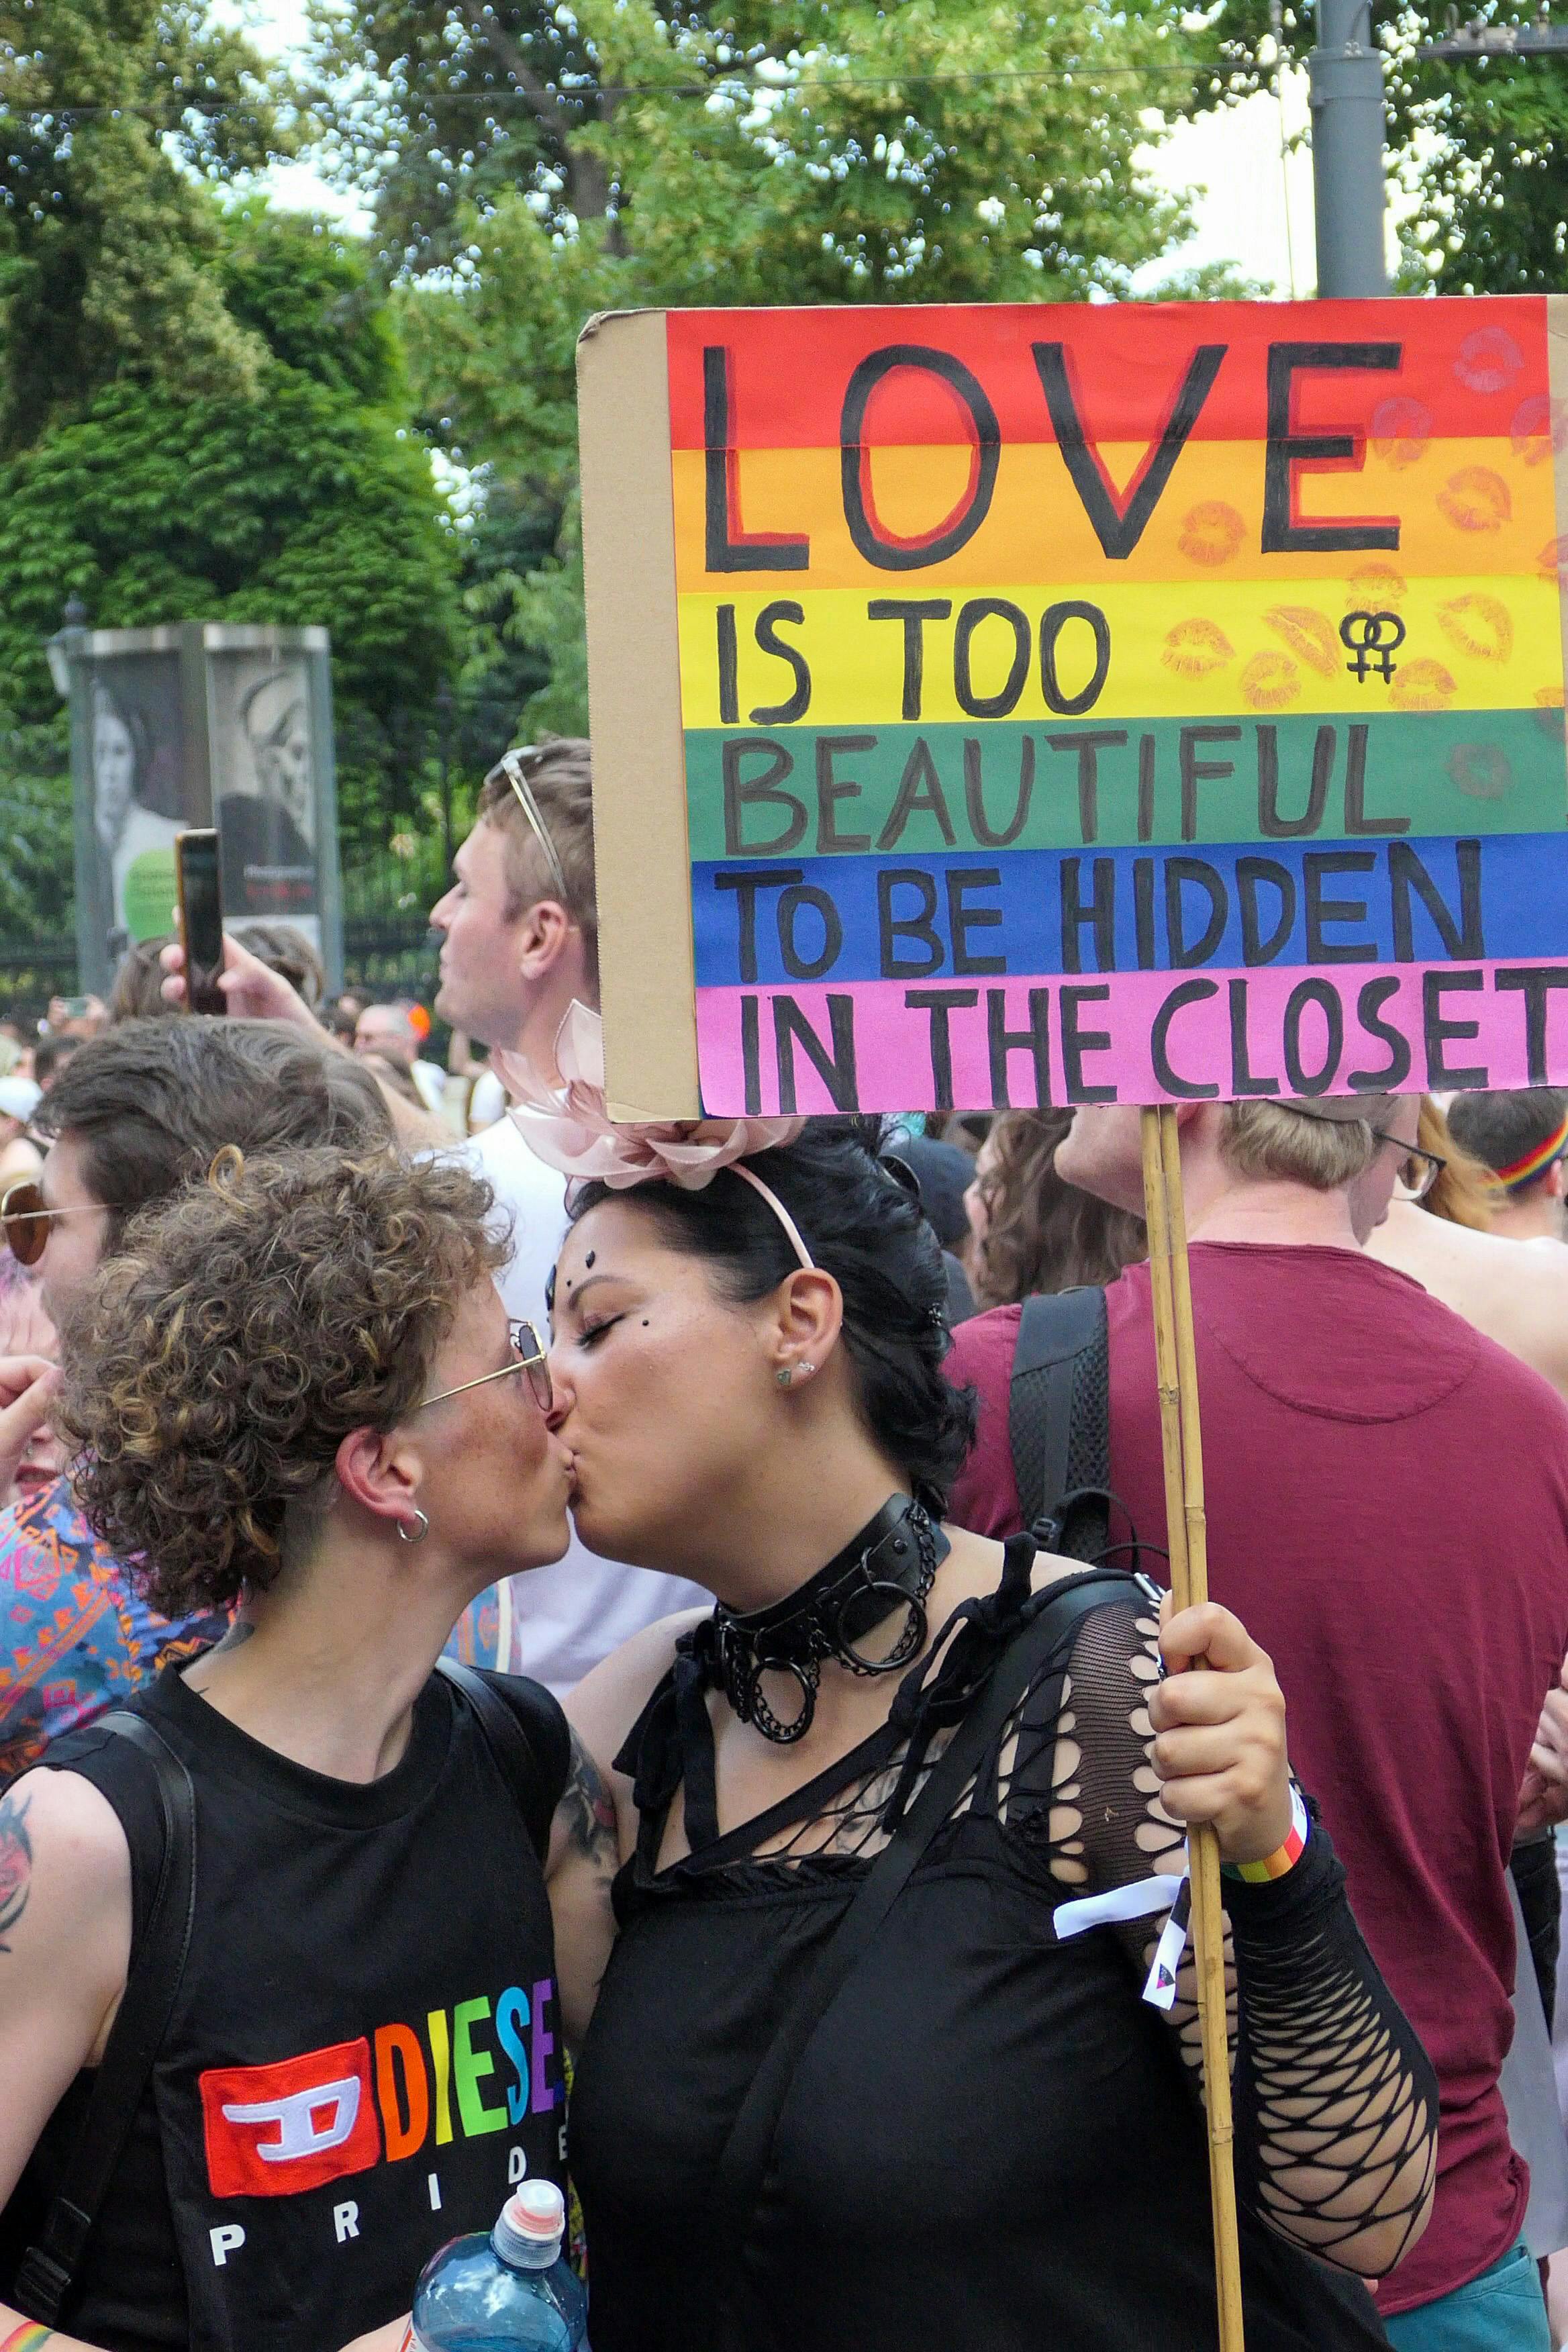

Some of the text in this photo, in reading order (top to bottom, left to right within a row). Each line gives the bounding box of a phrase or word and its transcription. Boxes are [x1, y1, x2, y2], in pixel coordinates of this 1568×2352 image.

[703, 341, 1403, 573] LOVE
[716, 597, 1111, 726] IS TOO
[722, 724, 1411, 856] BEAUTIFUL
[714, 839, 1485, 983] TO BE HIDDEN
[740, 966, 1568, 1116] IN THE CLOSET
[374, 1978, 564, 2163] DIESE
